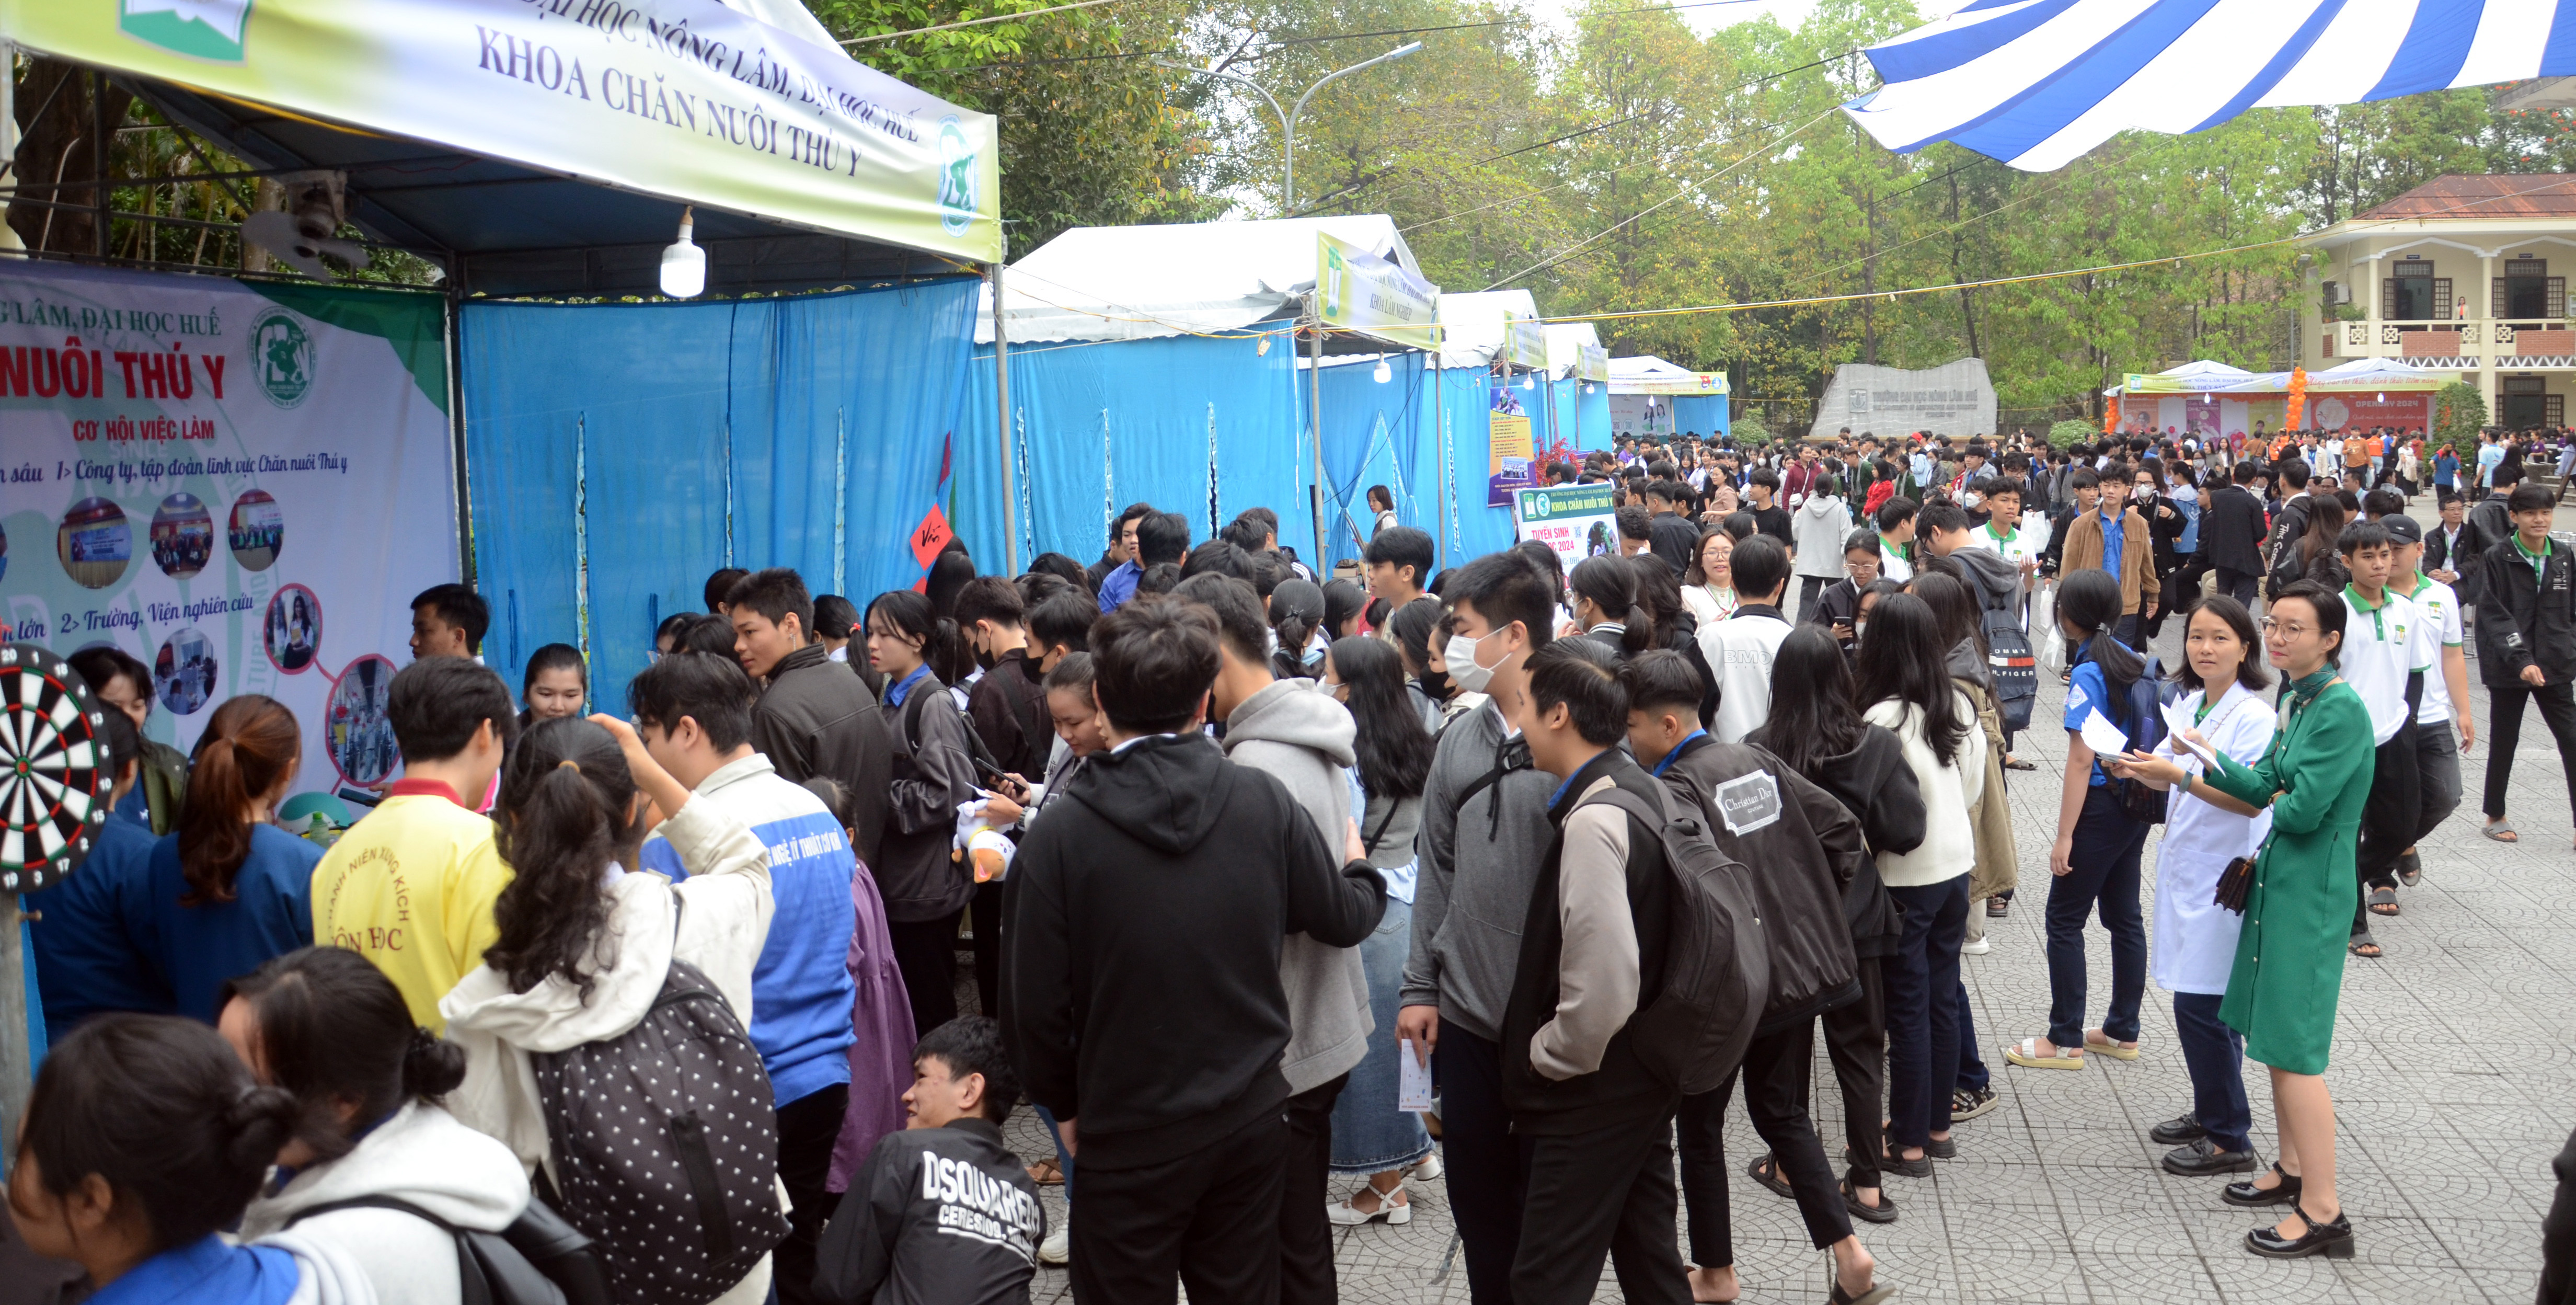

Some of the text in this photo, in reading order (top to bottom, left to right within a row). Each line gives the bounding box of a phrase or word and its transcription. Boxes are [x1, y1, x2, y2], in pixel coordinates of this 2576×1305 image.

[647, 17, 727, 73] NÔNG
[730, 47, 792, 101] LÂM,
[800, 74, 837, 116] ĐẠI
[838, 91, 880, 130] HỌC
[883, 107, 922, 143] HUẾ
[474, 25, 591, 101] KHOA
[602, 67, 696, 132] CHĂN
[706, 99, 777, 155] NUÔI
[847, 144, 862, 177] Y
[1369, 293, 1385, 312] KHOA
[1385, 295, 1396, 316] LÂM
[16, 297, 78, 331] LÂM,
[81, 306, 123, 337] ĐẠI
[129, 310, 174, 338] HỌC
[179, 306, 222, 336] HUẾ
[0, 335, 225, 400] NUÔI THÚ Y
[73, 415, 215, 445] CƠ HỘI VIỆC LÀM
[10, 462, 44, 483] sâu
[76, 459, 115, 485] Công
[141, 459, 164, 483] tập
[168, 456, 204, 476] đoàn
[235, 458, 256, 478] vực
[259, 454, 288, 472] Chăn
[291, 453, 316, 471] nuôi
[318, 452, 339, 470] Thú
[341, 456, 348, 474] y
[1551, 495, 1614, 512] KHOA CHĂN NUÔI THÚ Y
[1531, 525, 1570, 540] TUYỂN SINH
[1559, 540, 1574, 552] 2024
[18, 620, 47, 640] lớn
[84, 606, 144, 631] Trường,
[148, 601, 180, 626] Viện
[183, 595, 229, 622] nghiên
[231, 592, 254, 612] cứu
[1, 648, 18, 665] 20
[31, 650, 40, 666] 1
[1723, 650, 1777, 666] BMO
[54, 662, 68, 678] 18
[78, 684, 87, 698] 4
[90, 712, 104, 726] 13
[100, 744, 110, 758] 6
[98, 777, 112, 792] 10
[1724, 787, 1773, 811] Christian Dior
[91, 809, 106, 825] 15
[1747, 804, 1764, 813] COUTURE
[79, 837, 89, 852] 2
[56, 857, 71, 874] 17
[3, 872, 19, 890] 19
[33, 870, 43, 887] 3
[393, 875, 410, 922] KÍCH
